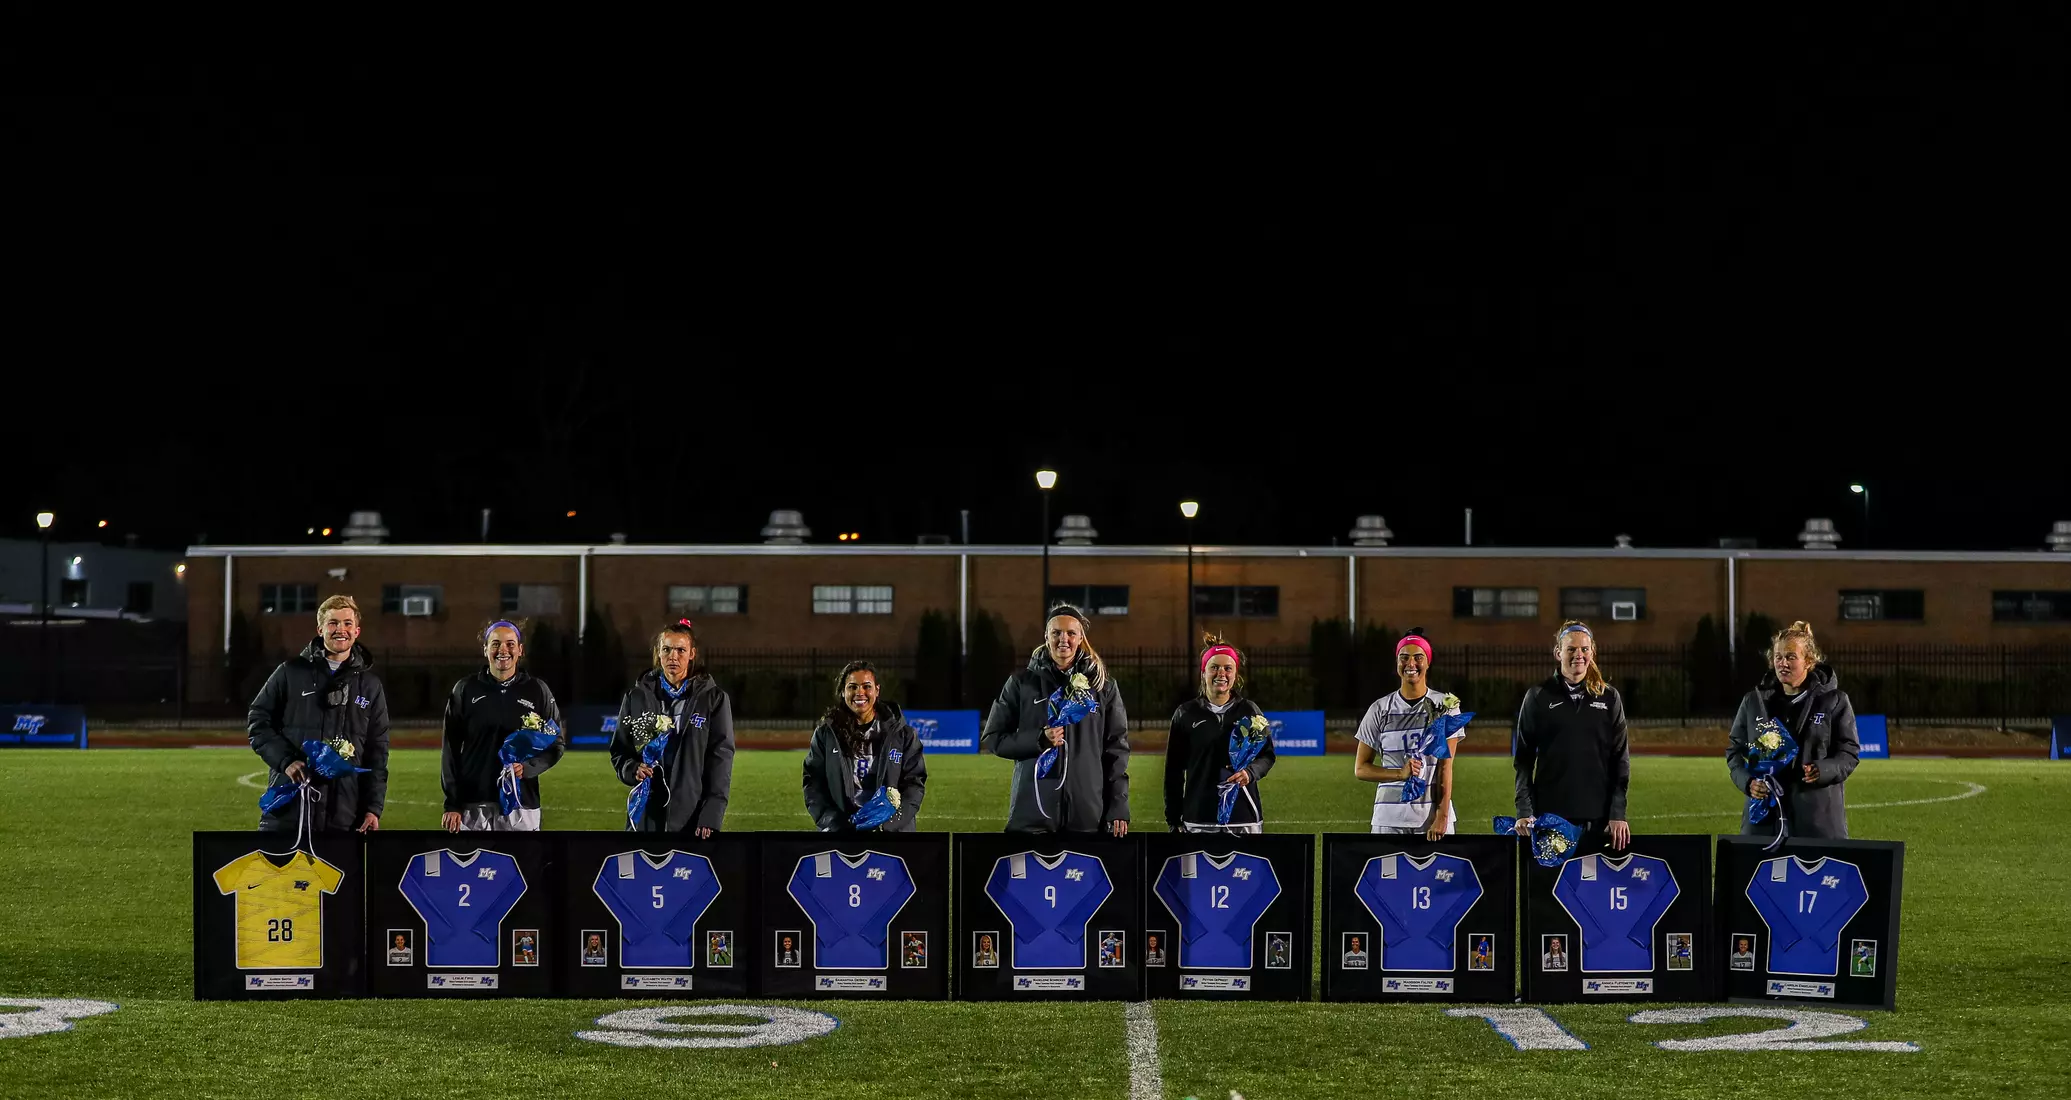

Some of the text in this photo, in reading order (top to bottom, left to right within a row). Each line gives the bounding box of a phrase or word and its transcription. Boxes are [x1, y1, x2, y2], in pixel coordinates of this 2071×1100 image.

[13, 714, 46, 736] MT
[477, 867, 497, 880] MT
[672, 867, 692, 880] MT
[866, 868, 886, 881] MT
[1064, 868, 1084, 882] MT
[1232, 867, 1252, 880] MT
[1434, 869, 1454, 882] MT
[1631, 867, 1650, 881] MT
[1821, 875, 1840, 889] MT
[458, 883, 471, 907] 2
[652, 885, 664, 909] 5
[848, 884, 861, 908] 8
[1044, 885, 1056, 909] 9
[1211, 885, 1229, 909] 12
[1412, 886, 1431, 910] 13
[1610, 886, 1628, 910] 15
[1799, 890, 1818, 914] 17
[268, 919, 293, 942] 28
[250, 977, 264, 987] MT
[297, 977, 311, 987] MT
[431, 976, 446, 986] MT
[480, 976, 495, 986] MT
[625, 977, 640, 987] MT
[674, 977, 689, 987] MT
[820, 978, 834, 988] MT
[868, 978, 883, 988] MT
[1018, 978, 1032, 988] MT
[1066, 978, 1081, 988] MT
[1184, 978, 1198, 987] MT
[1232, 978, 1247, 988] MT
[1386, 980, 1401, 990] MT
[1435, 980, 1450, 991] MT
[1587, 981, 1601, 991] MT
[1635, 981, 1650, 991] MT
[1770, 982, 1785, 992] MT
[1817, 985, 1831, 995] MT
[1440, 1006, 1923, 1052] 12
